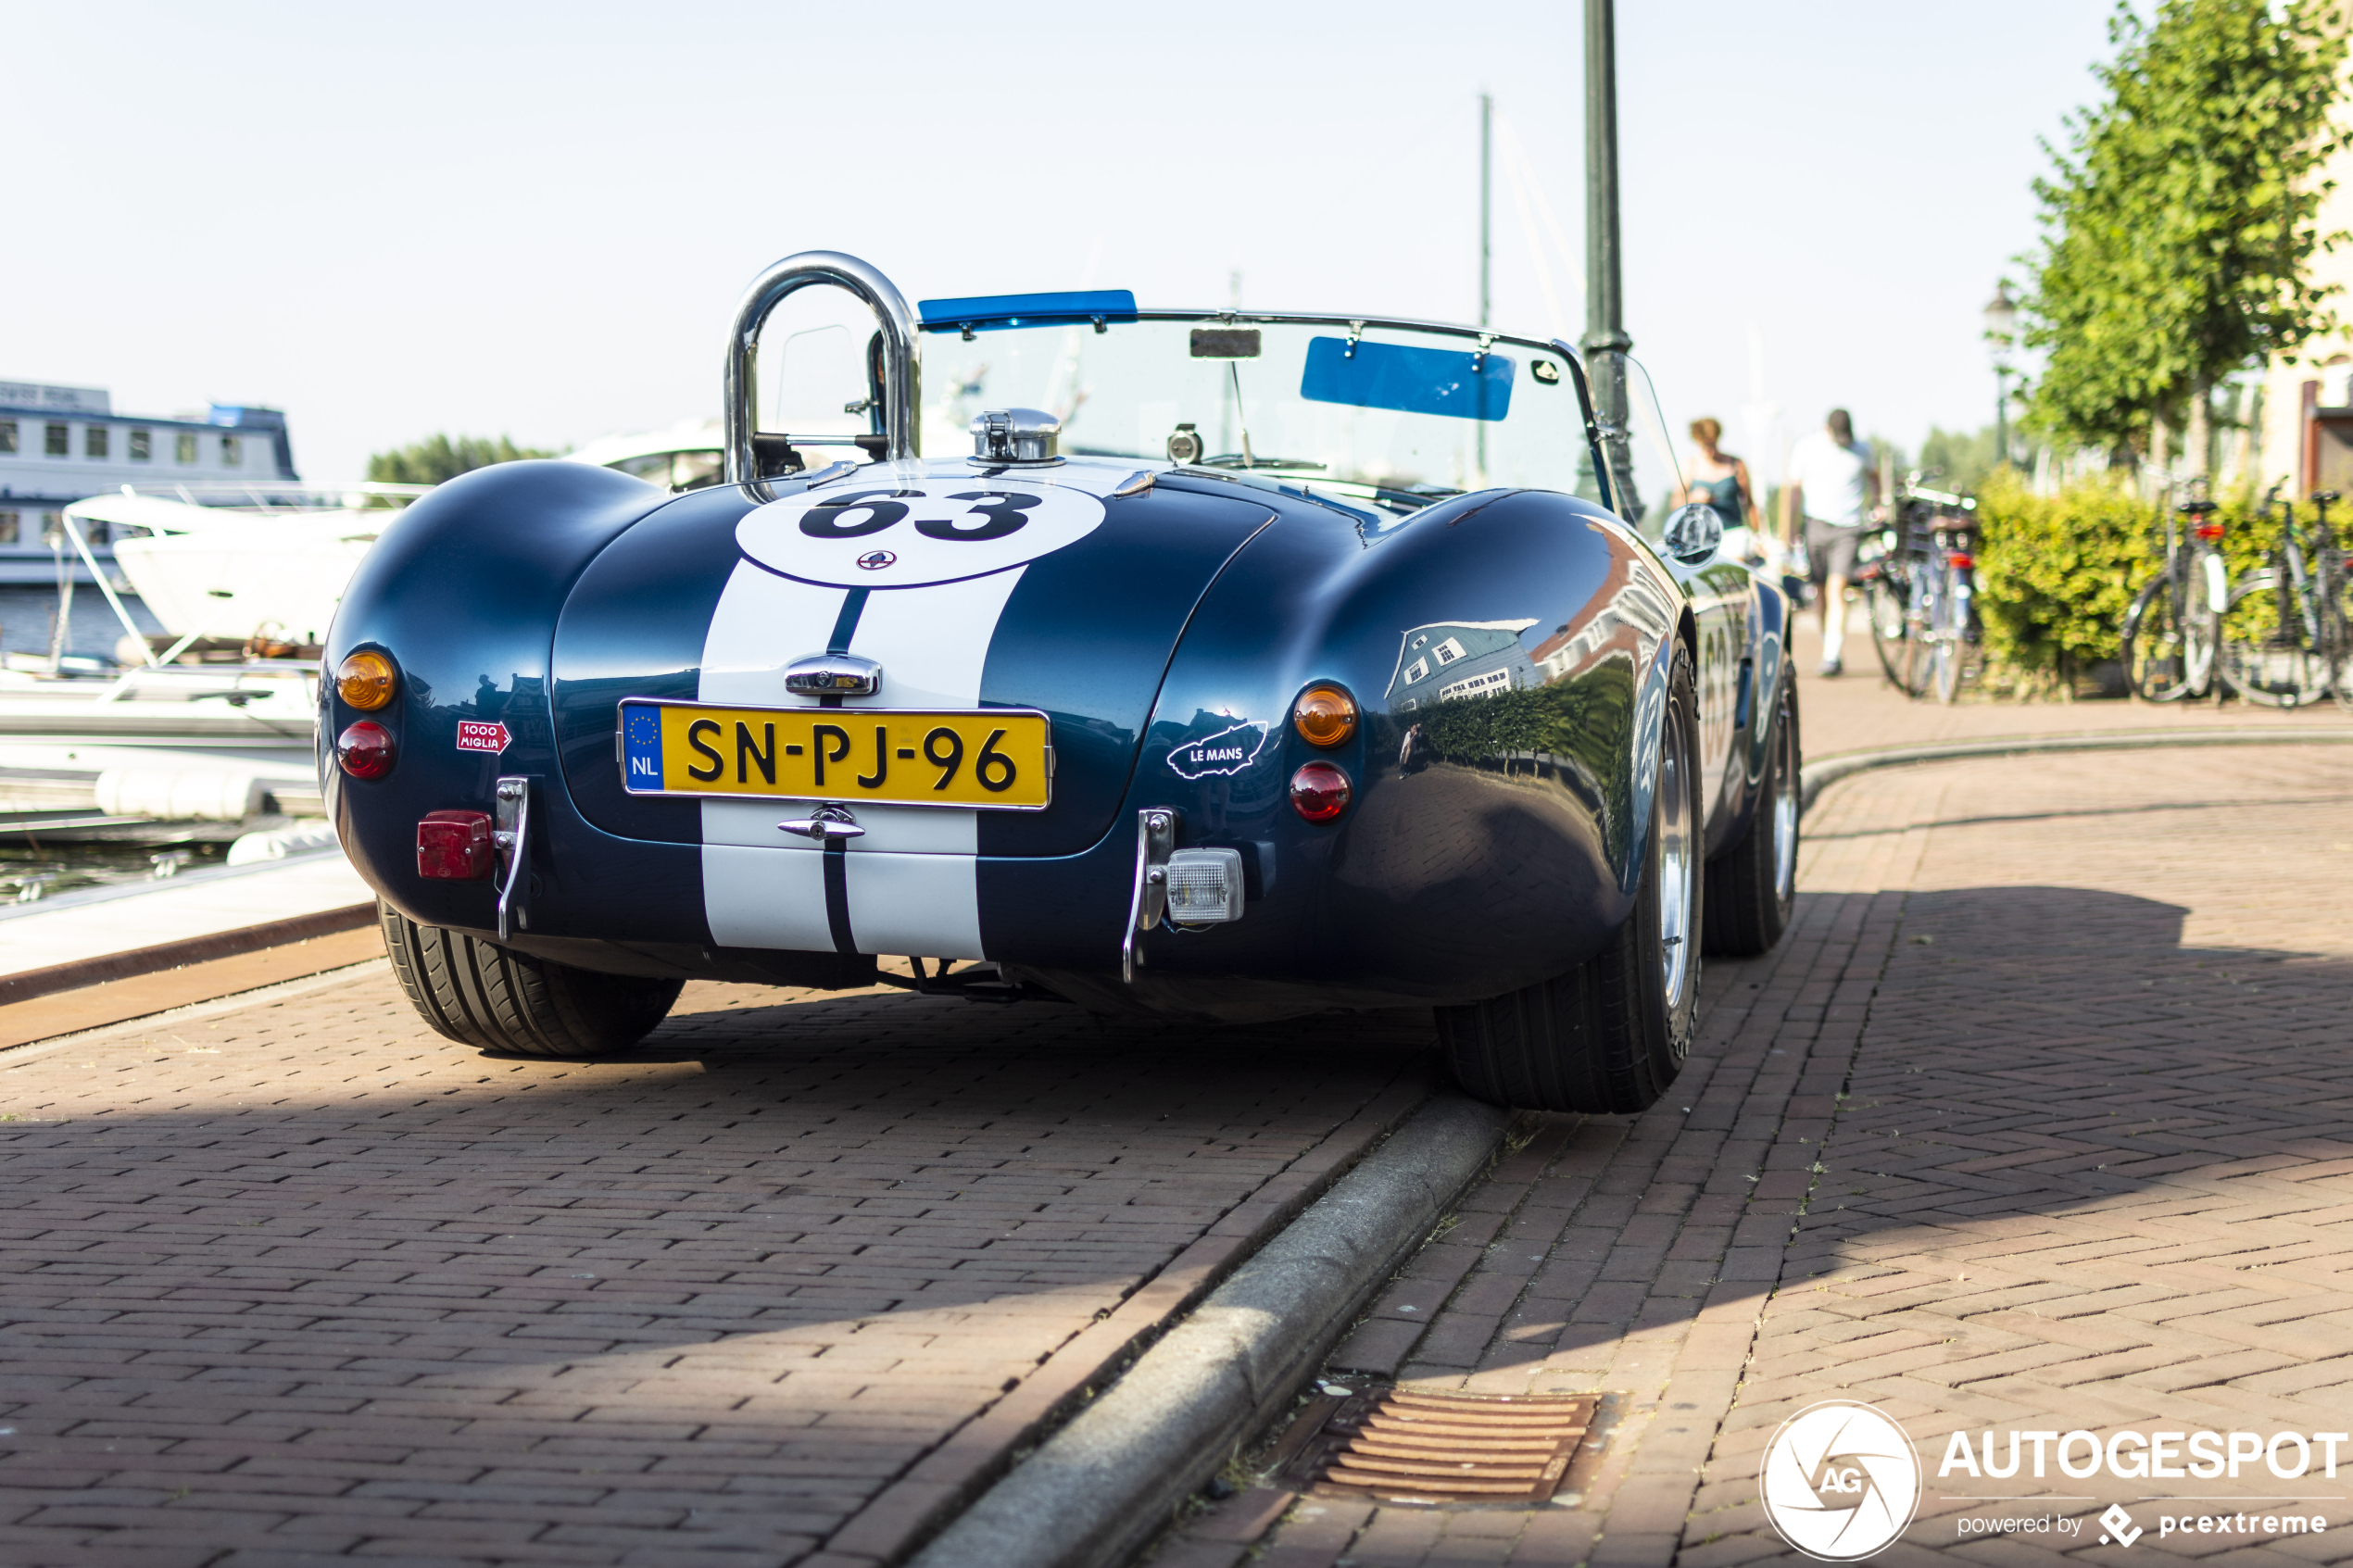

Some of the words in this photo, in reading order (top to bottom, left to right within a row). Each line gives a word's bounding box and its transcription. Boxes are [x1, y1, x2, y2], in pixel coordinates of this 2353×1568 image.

[799, 489, 1043, 541] 63
[464, 724, 497, 736] 1000
[460, 737, 498, 748] MIGLIA
[687, 718, 1017, 793] SN-PJ-96
[1190, 750, 1204, 762] LE
[1206, 747, 1242, 761] MANS
[632, 756, 659, 776] NL
